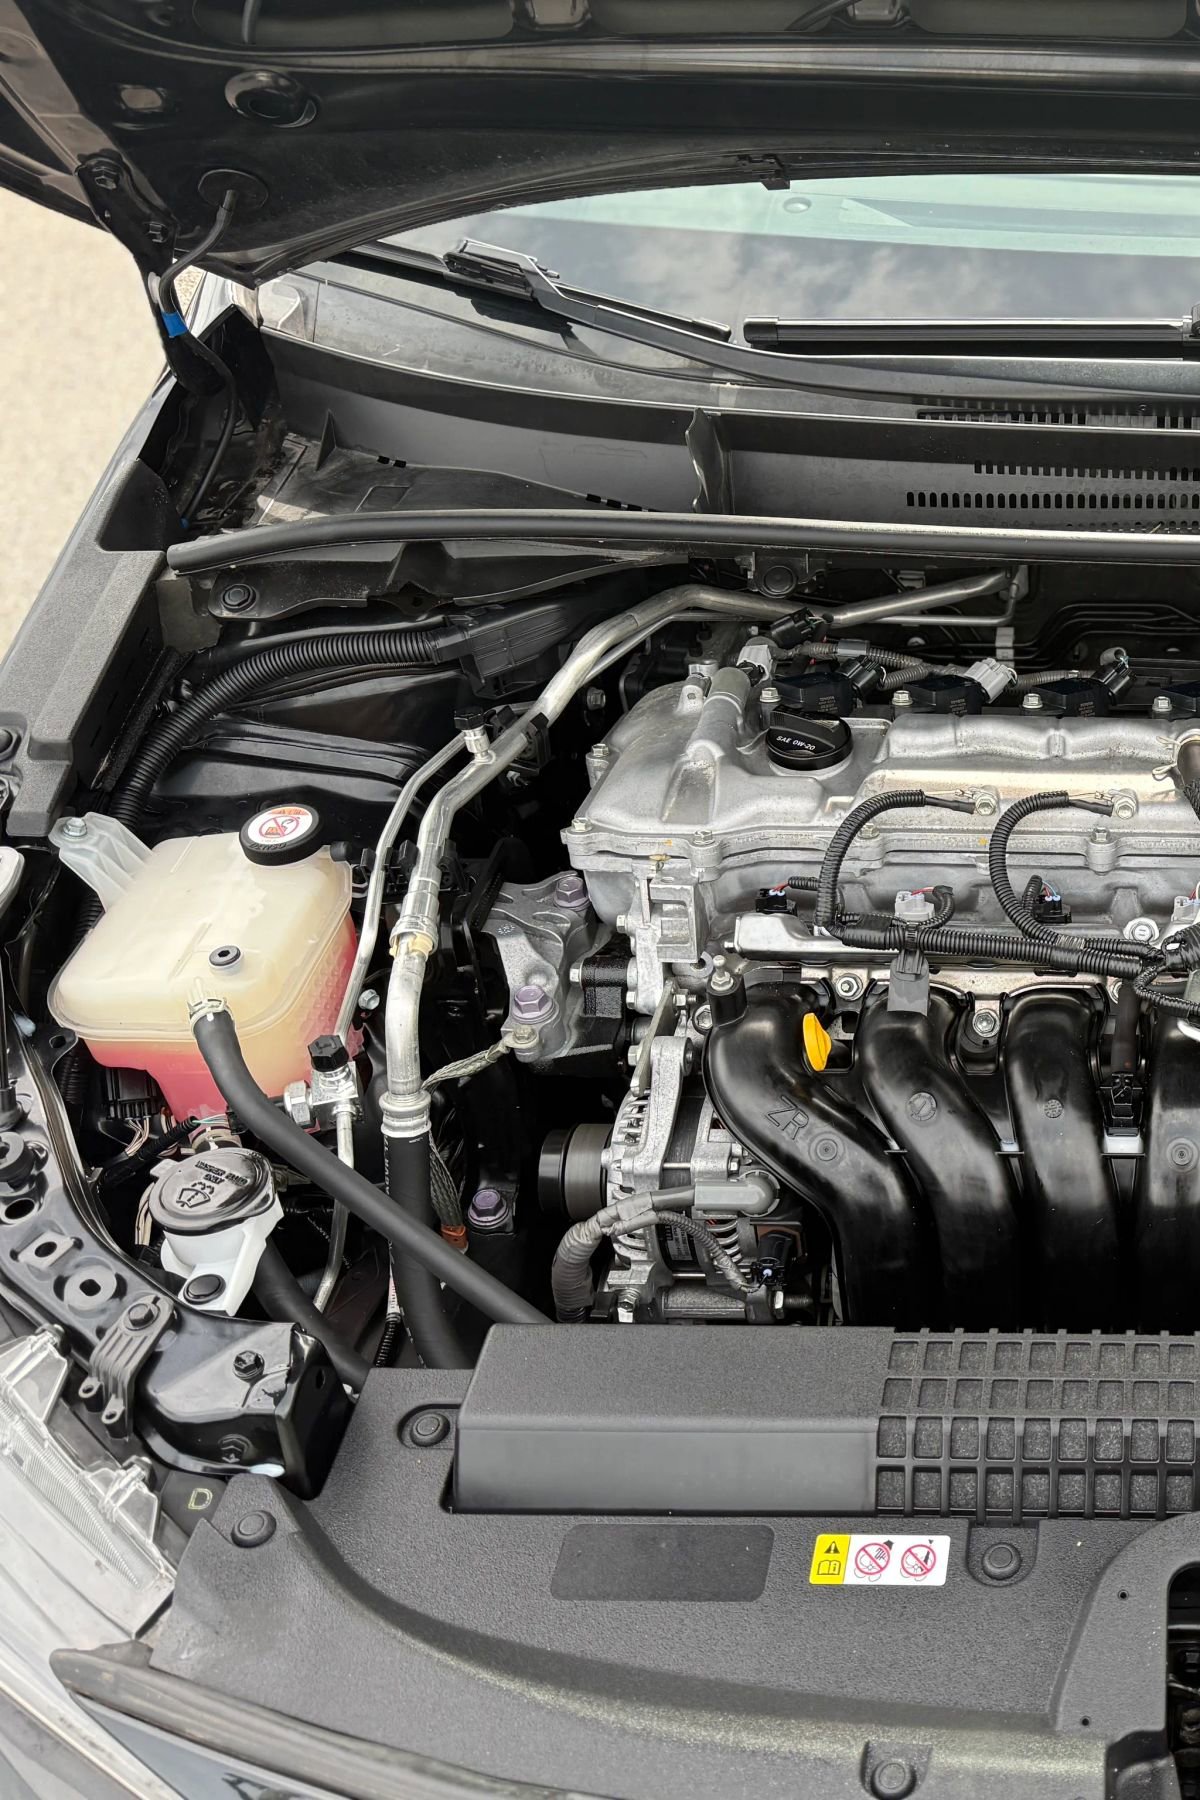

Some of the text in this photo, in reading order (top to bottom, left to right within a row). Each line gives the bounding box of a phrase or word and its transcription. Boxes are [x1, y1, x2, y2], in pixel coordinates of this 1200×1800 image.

[776, 735, 816, 751] SAE 0W-20
[764, 1095, 810, 1140] ZR
[187, 1487, 214, 1510] D
